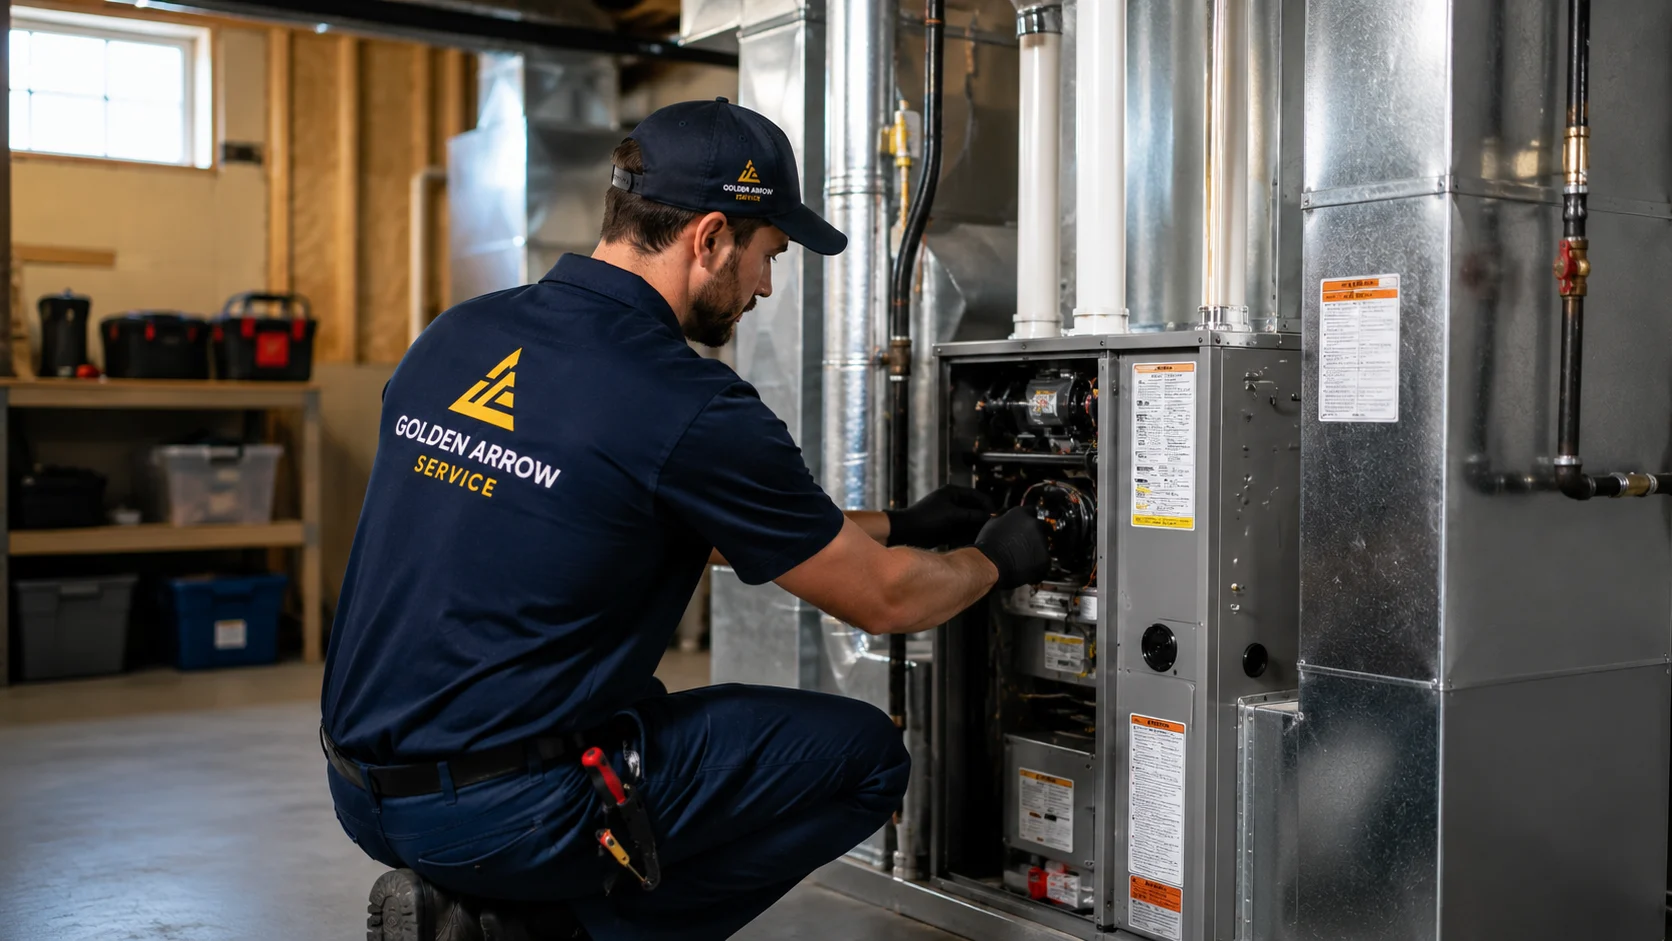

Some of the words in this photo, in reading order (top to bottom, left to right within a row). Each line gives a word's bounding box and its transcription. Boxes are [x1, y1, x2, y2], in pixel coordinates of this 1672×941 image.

[395, 415, 471, 456] GOLDEN
[468, 440, 561, 489] ARROW
[414, 455, 497, 498] SERVICE
